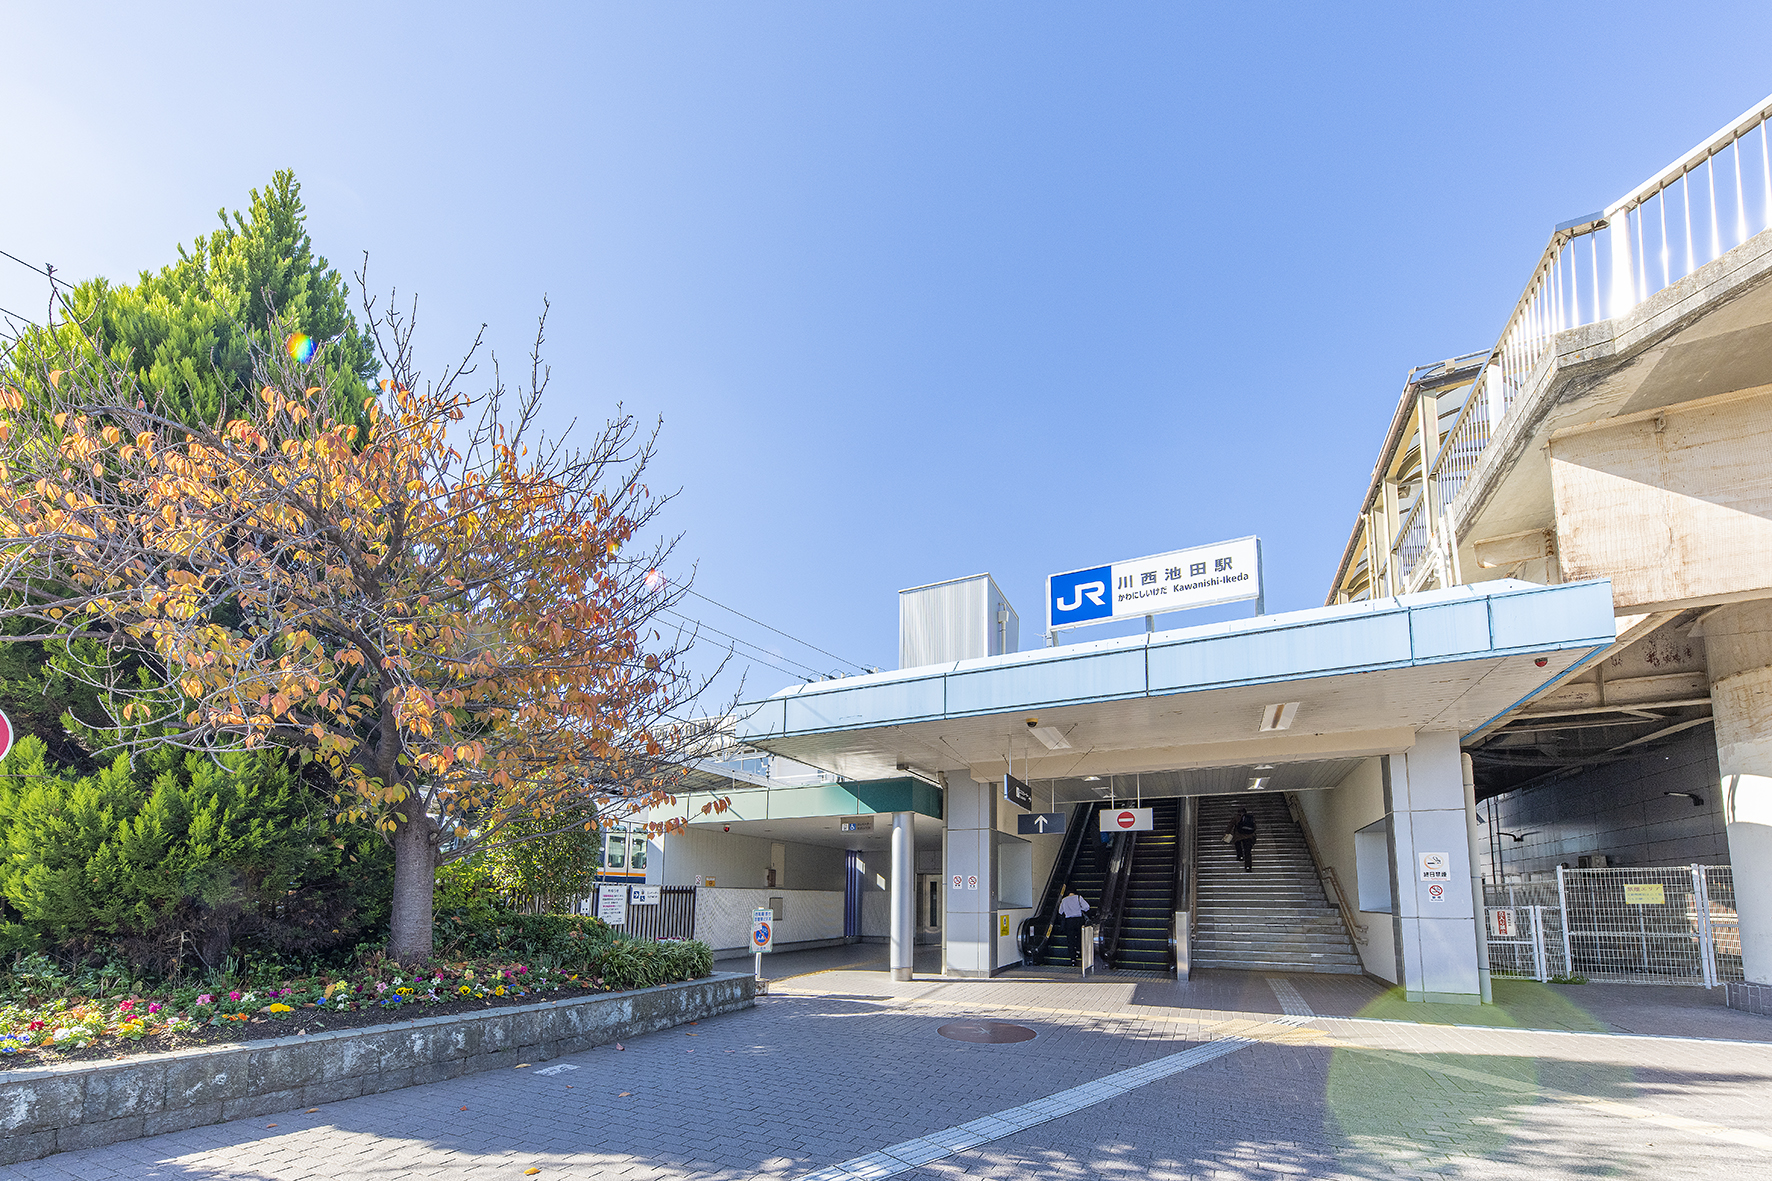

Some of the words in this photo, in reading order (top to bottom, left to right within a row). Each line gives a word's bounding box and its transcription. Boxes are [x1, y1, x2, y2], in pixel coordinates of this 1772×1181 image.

[1118, 557, 1233, 590] 川西池田駅
[1173, 572, 1249, 593] Kawanishi-Ikeda
[1057, 581, 1106, 611] JR
[1118, 586, 1168, 602] かわにしいけだ
